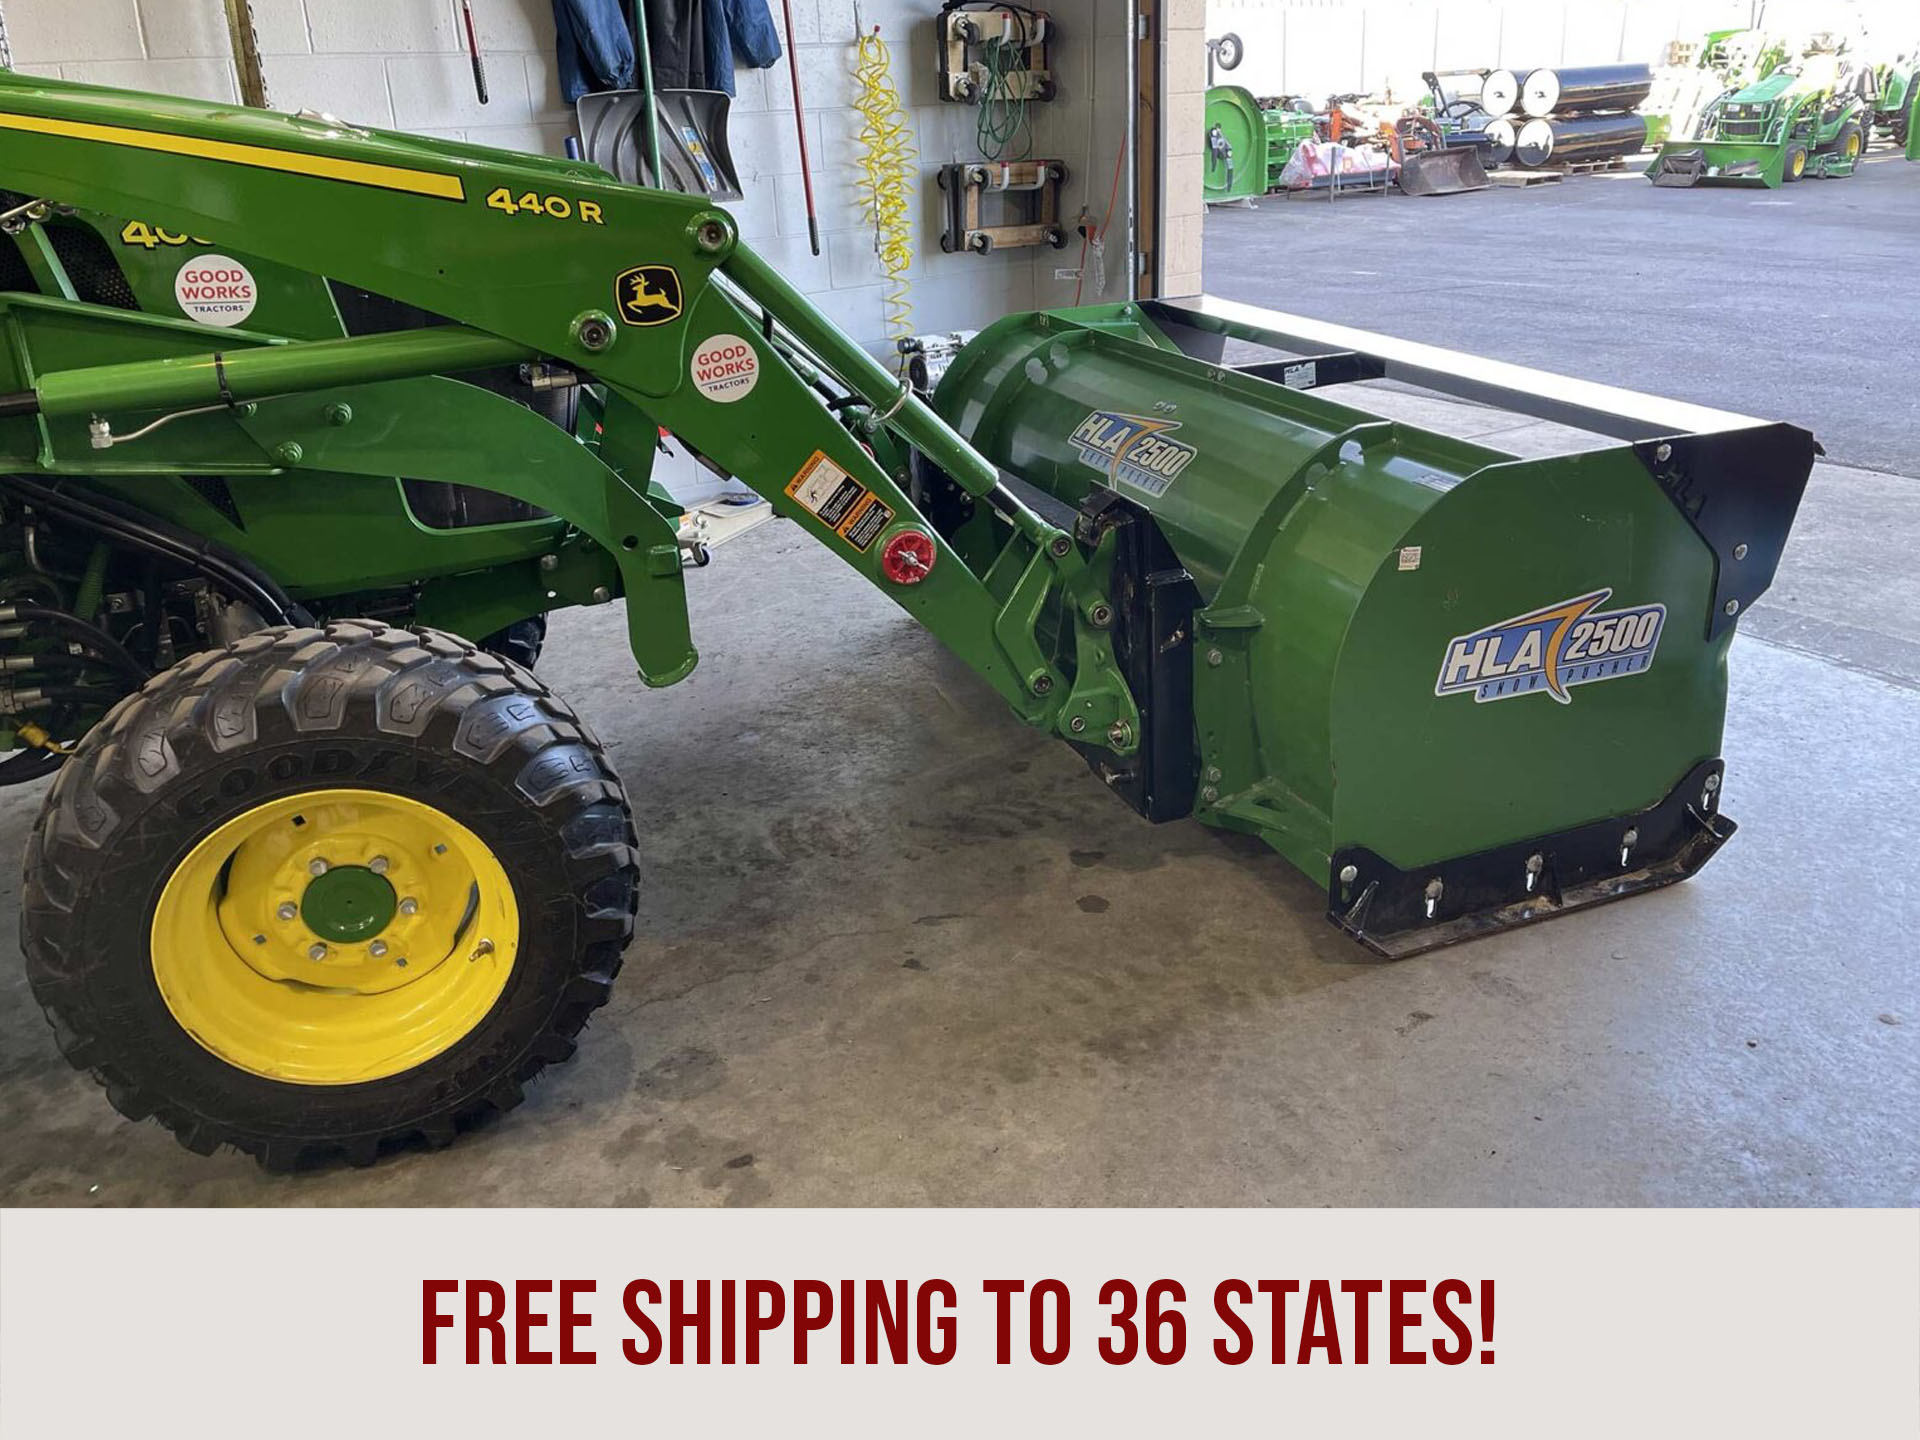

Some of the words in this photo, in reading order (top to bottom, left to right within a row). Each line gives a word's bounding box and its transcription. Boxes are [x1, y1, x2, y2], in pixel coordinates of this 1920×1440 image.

[486, 187, 572, 219] 440
[577, 199, 605, 225] R
[121, 220, 216, 249] 40
[184, 270, 244, 284] GOOD
[181, 285, 252, 300] WORKS
[194, 304, 245, 313] TRACTORS
[697, 345, 747, 366] GOOD
[696, 358, 755, 382] WORKS
[708, 377, 750, 392] TRACTORS
[1074, 414, 1132, 454] HLA
[1127, 436, 1192, 477] 2500
[796, 455, 820, 484] WARNING
[849, 497, 872, 524] WARNING
[1444, 629, 1543, 686] HLA
[1563, 611, 1662, 662] 2500
[1480, 675, 1538, 698] SNOW
[1566, 656, 1649, 682] PUSHER
